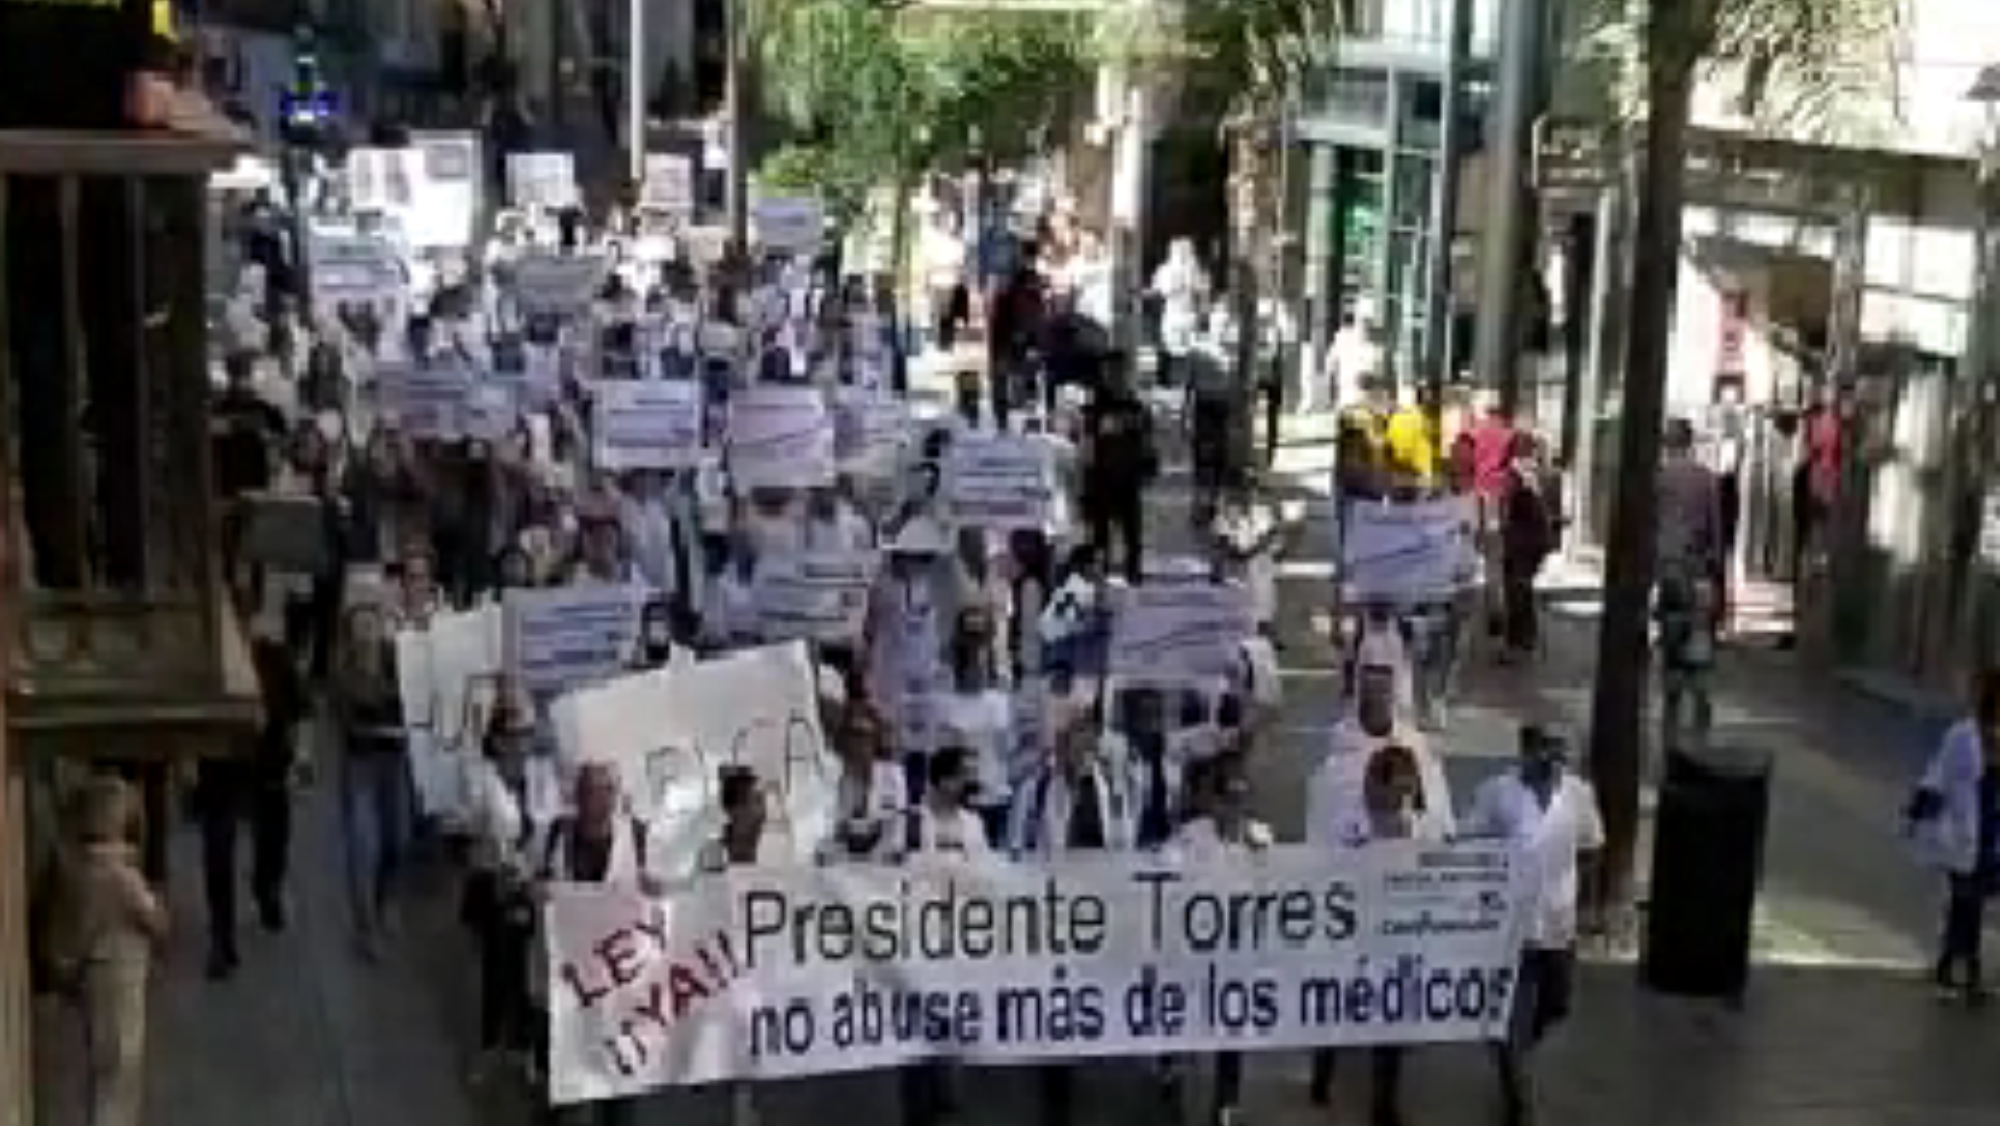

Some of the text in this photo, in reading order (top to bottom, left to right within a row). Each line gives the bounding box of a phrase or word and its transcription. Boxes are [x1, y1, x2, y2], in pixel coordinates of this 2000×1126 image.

[562, 908, 666, 1007] LEY
[745, 871, 1357, 969] Presidente Torres
[751, 997, 815, 1058] no
[832, 974, 983, 1050] abuse
[996, 964, 1104, 1041] más
[1124, 963, 1187, 1037] de
[1207, 962, 1279, 1032] los
